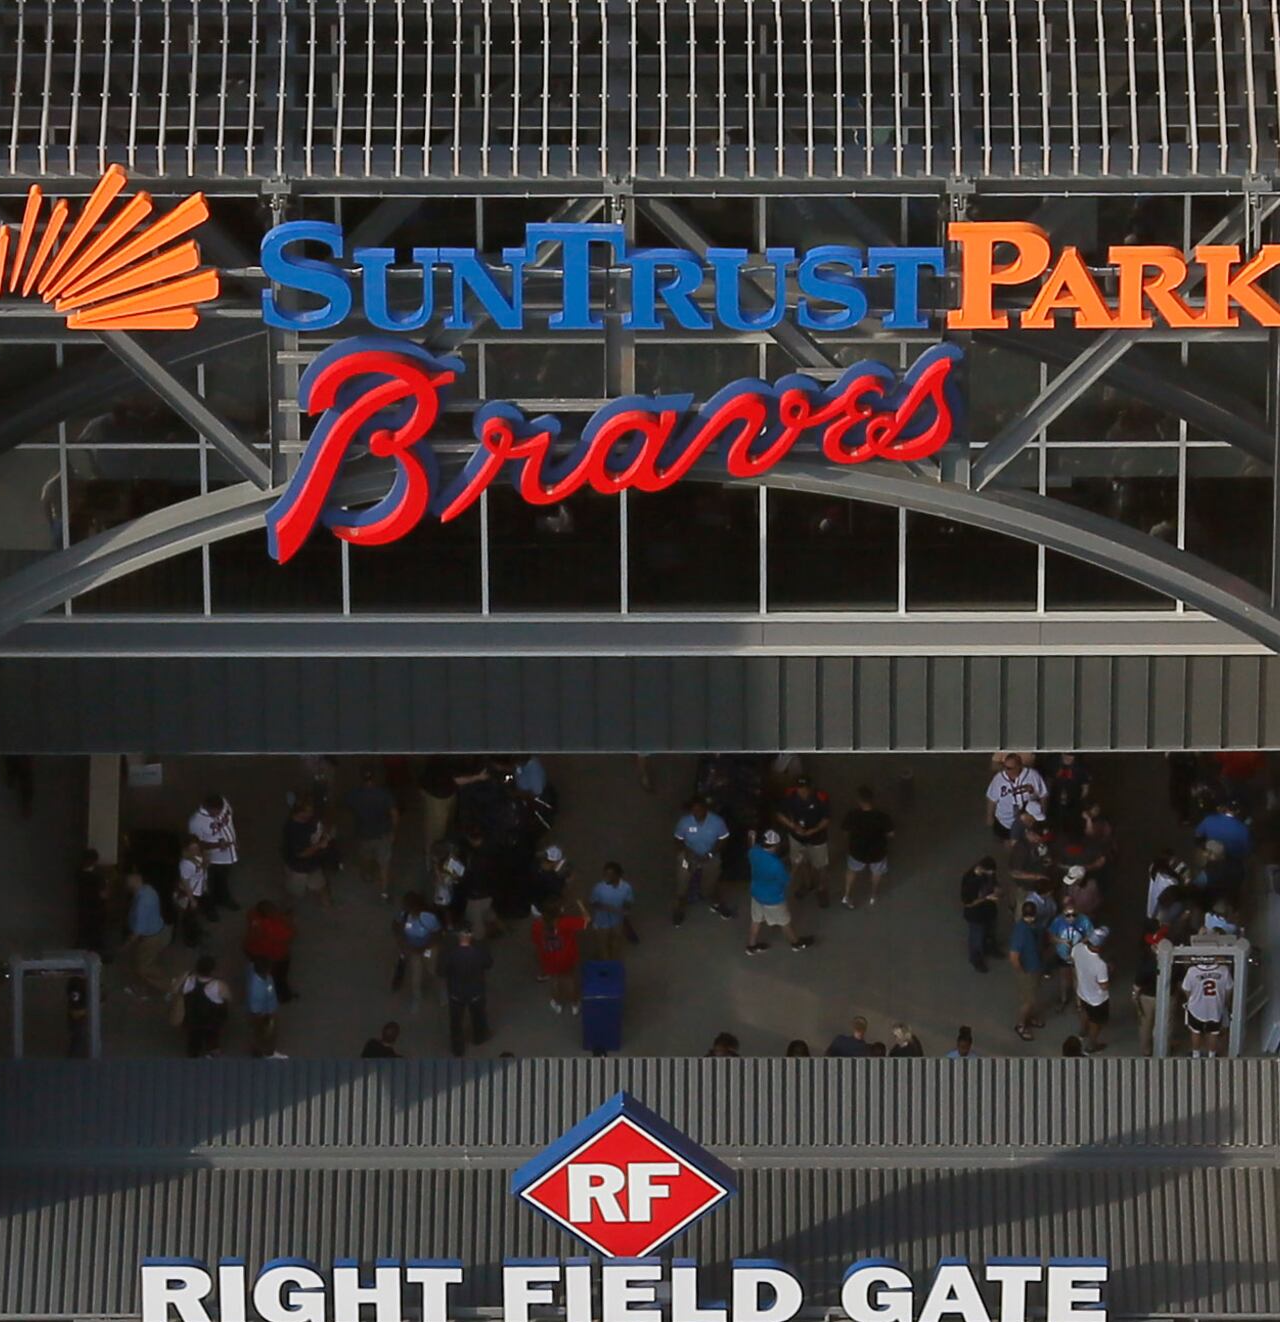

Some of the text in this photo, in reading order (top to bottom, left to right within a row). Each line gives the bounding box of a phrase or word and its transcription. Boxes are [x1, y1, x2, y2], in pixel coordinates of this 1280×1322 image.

[260, 218, 948, 332] SUNTRUST
[266, 340, 966, 564] Braves
[1202, 980, 1218, 997] 2
[567, 1161, 680, 1223] RF
